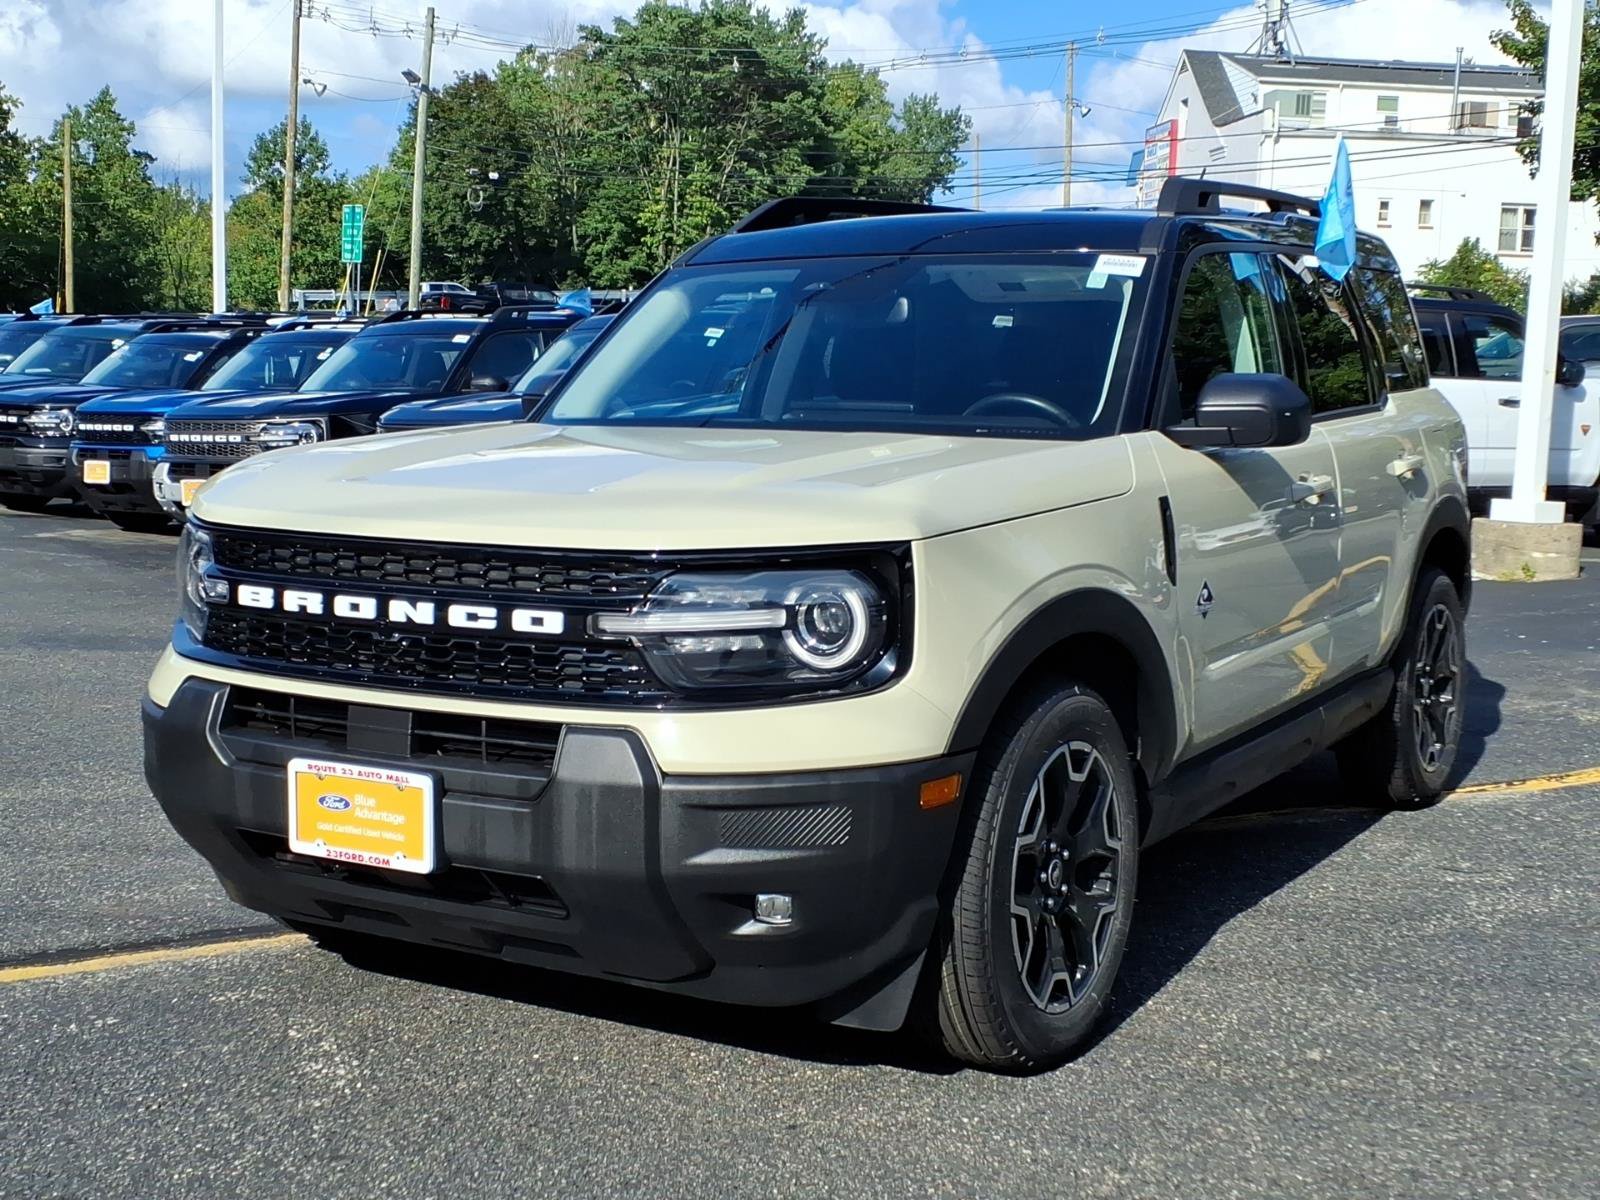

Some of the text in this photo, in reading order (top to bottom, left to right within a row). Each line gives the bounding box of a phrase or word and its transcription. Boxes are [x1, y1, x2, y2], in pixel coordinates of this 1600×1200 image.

[79, 423, 134, 431] BRONCO
[169, 434, 242, 442] BRONCO
[237, 584, 565, 634] BRONCO
[307, 763, 410, 784] ROUTE 23 AUTO MALL
[323, 795, 347, 810] Ford
[354, 794, 376, 807] Blue
[354, 808, 406, 825] Advantage
[381, 830, 405, 842] Vehicle
[326, 849, 391, 866] 23FORD.COM
